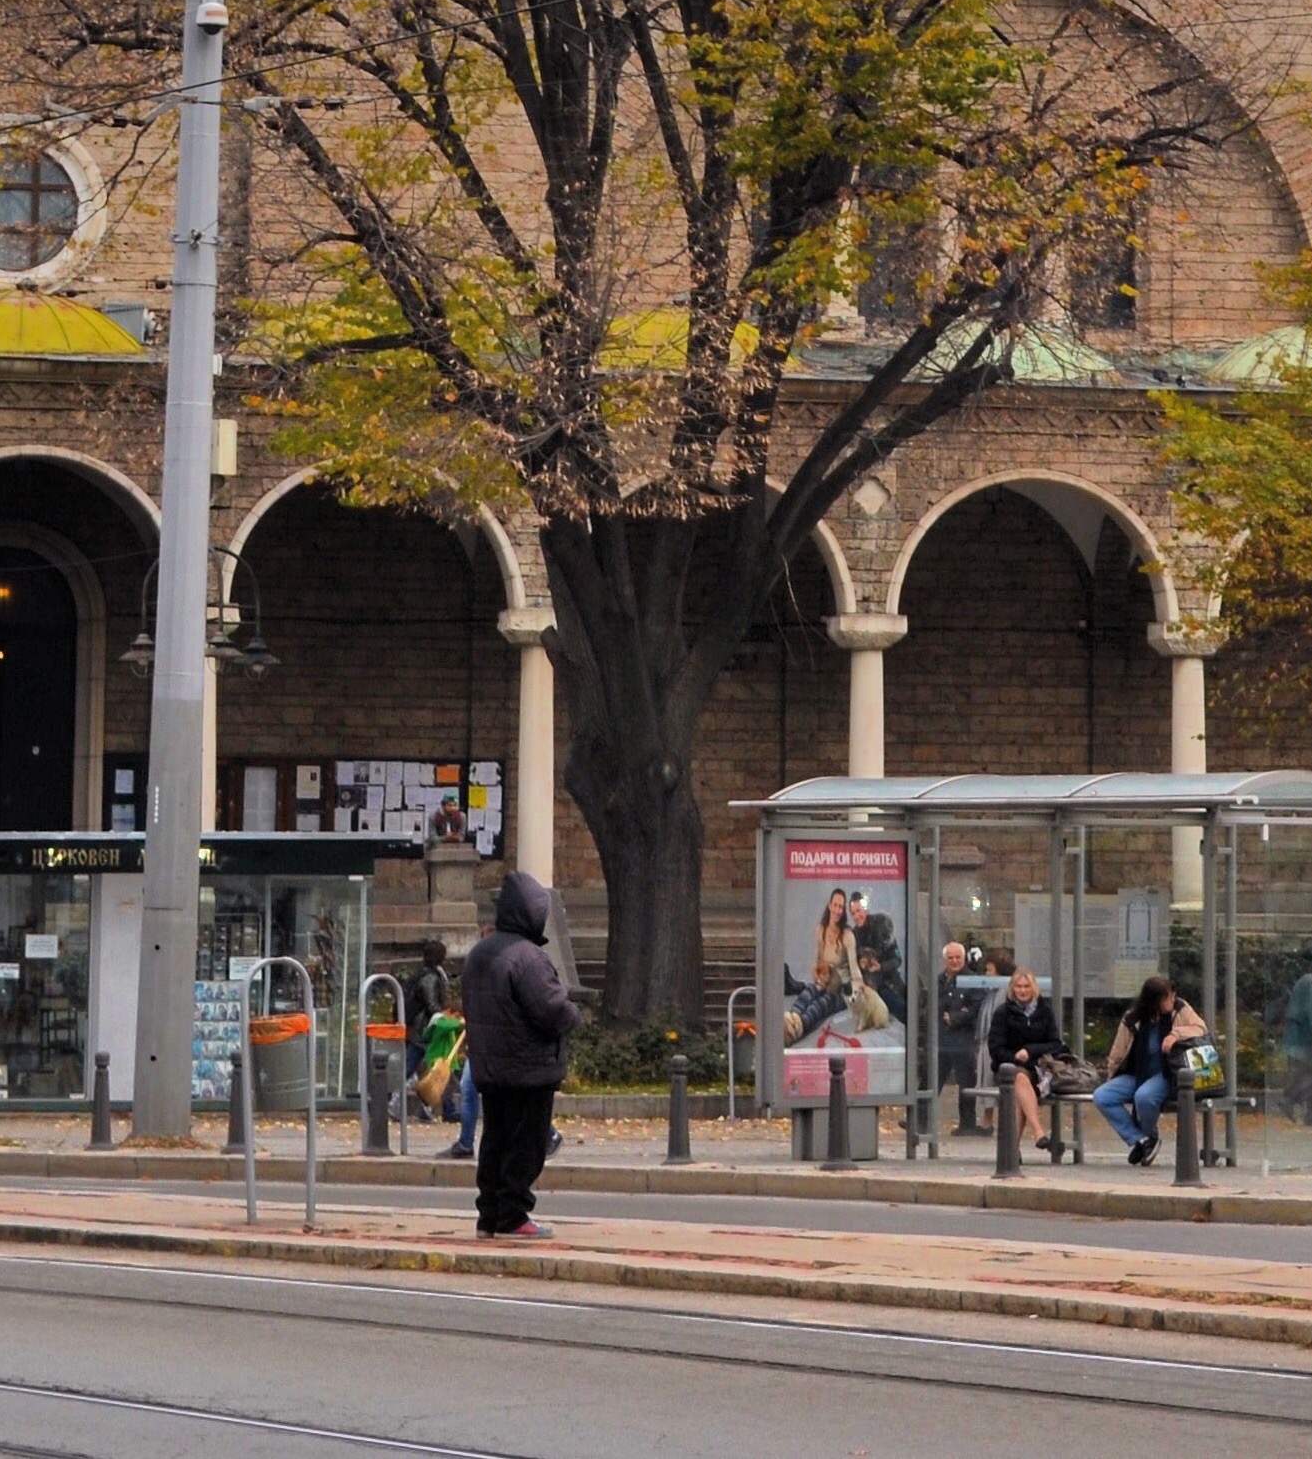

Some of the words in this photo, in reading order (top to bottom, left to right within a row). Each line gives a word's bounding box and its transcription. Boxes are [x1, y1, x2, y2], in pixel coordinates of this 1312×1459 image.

[790, 851, 834, 866] ПОДАРИ
[836, 852, 850, 865] СИ
[852, 852, 898, 866] ПРИЯТЕЛ
